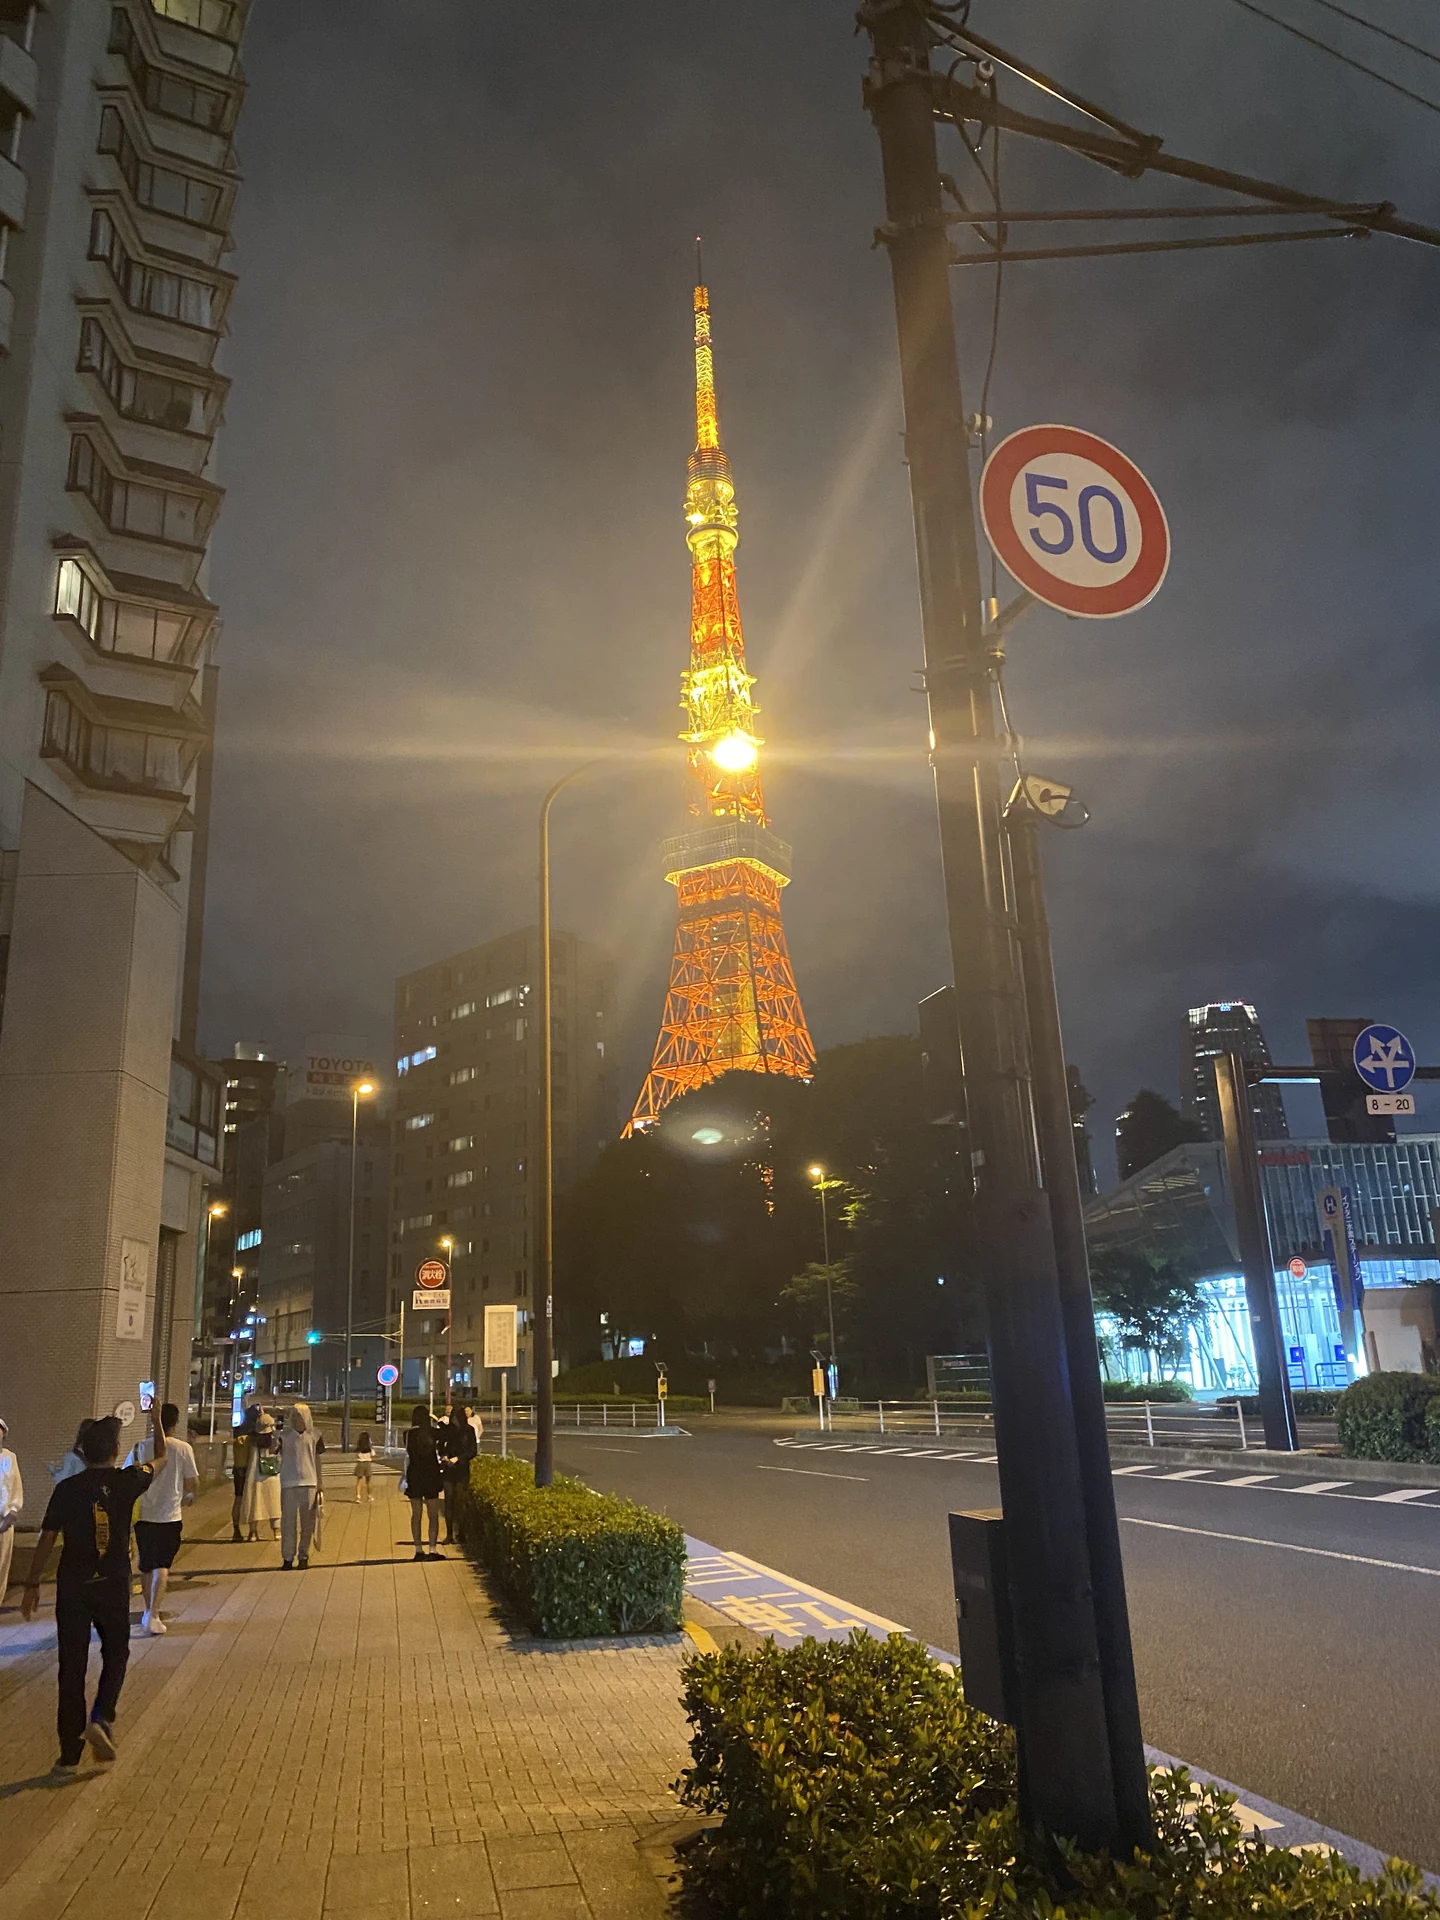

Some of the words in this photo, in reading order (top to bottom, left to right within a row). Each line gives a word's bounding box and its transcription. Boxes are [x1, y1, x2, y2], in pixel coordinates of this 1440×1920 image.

[1025, 472, 1128, 564] 50
[307, 1056, 374, 1073] TOYOTA
[1372, 1099, 1379, 1110] 8
[1395, 1098, 1410, 1110] 20
